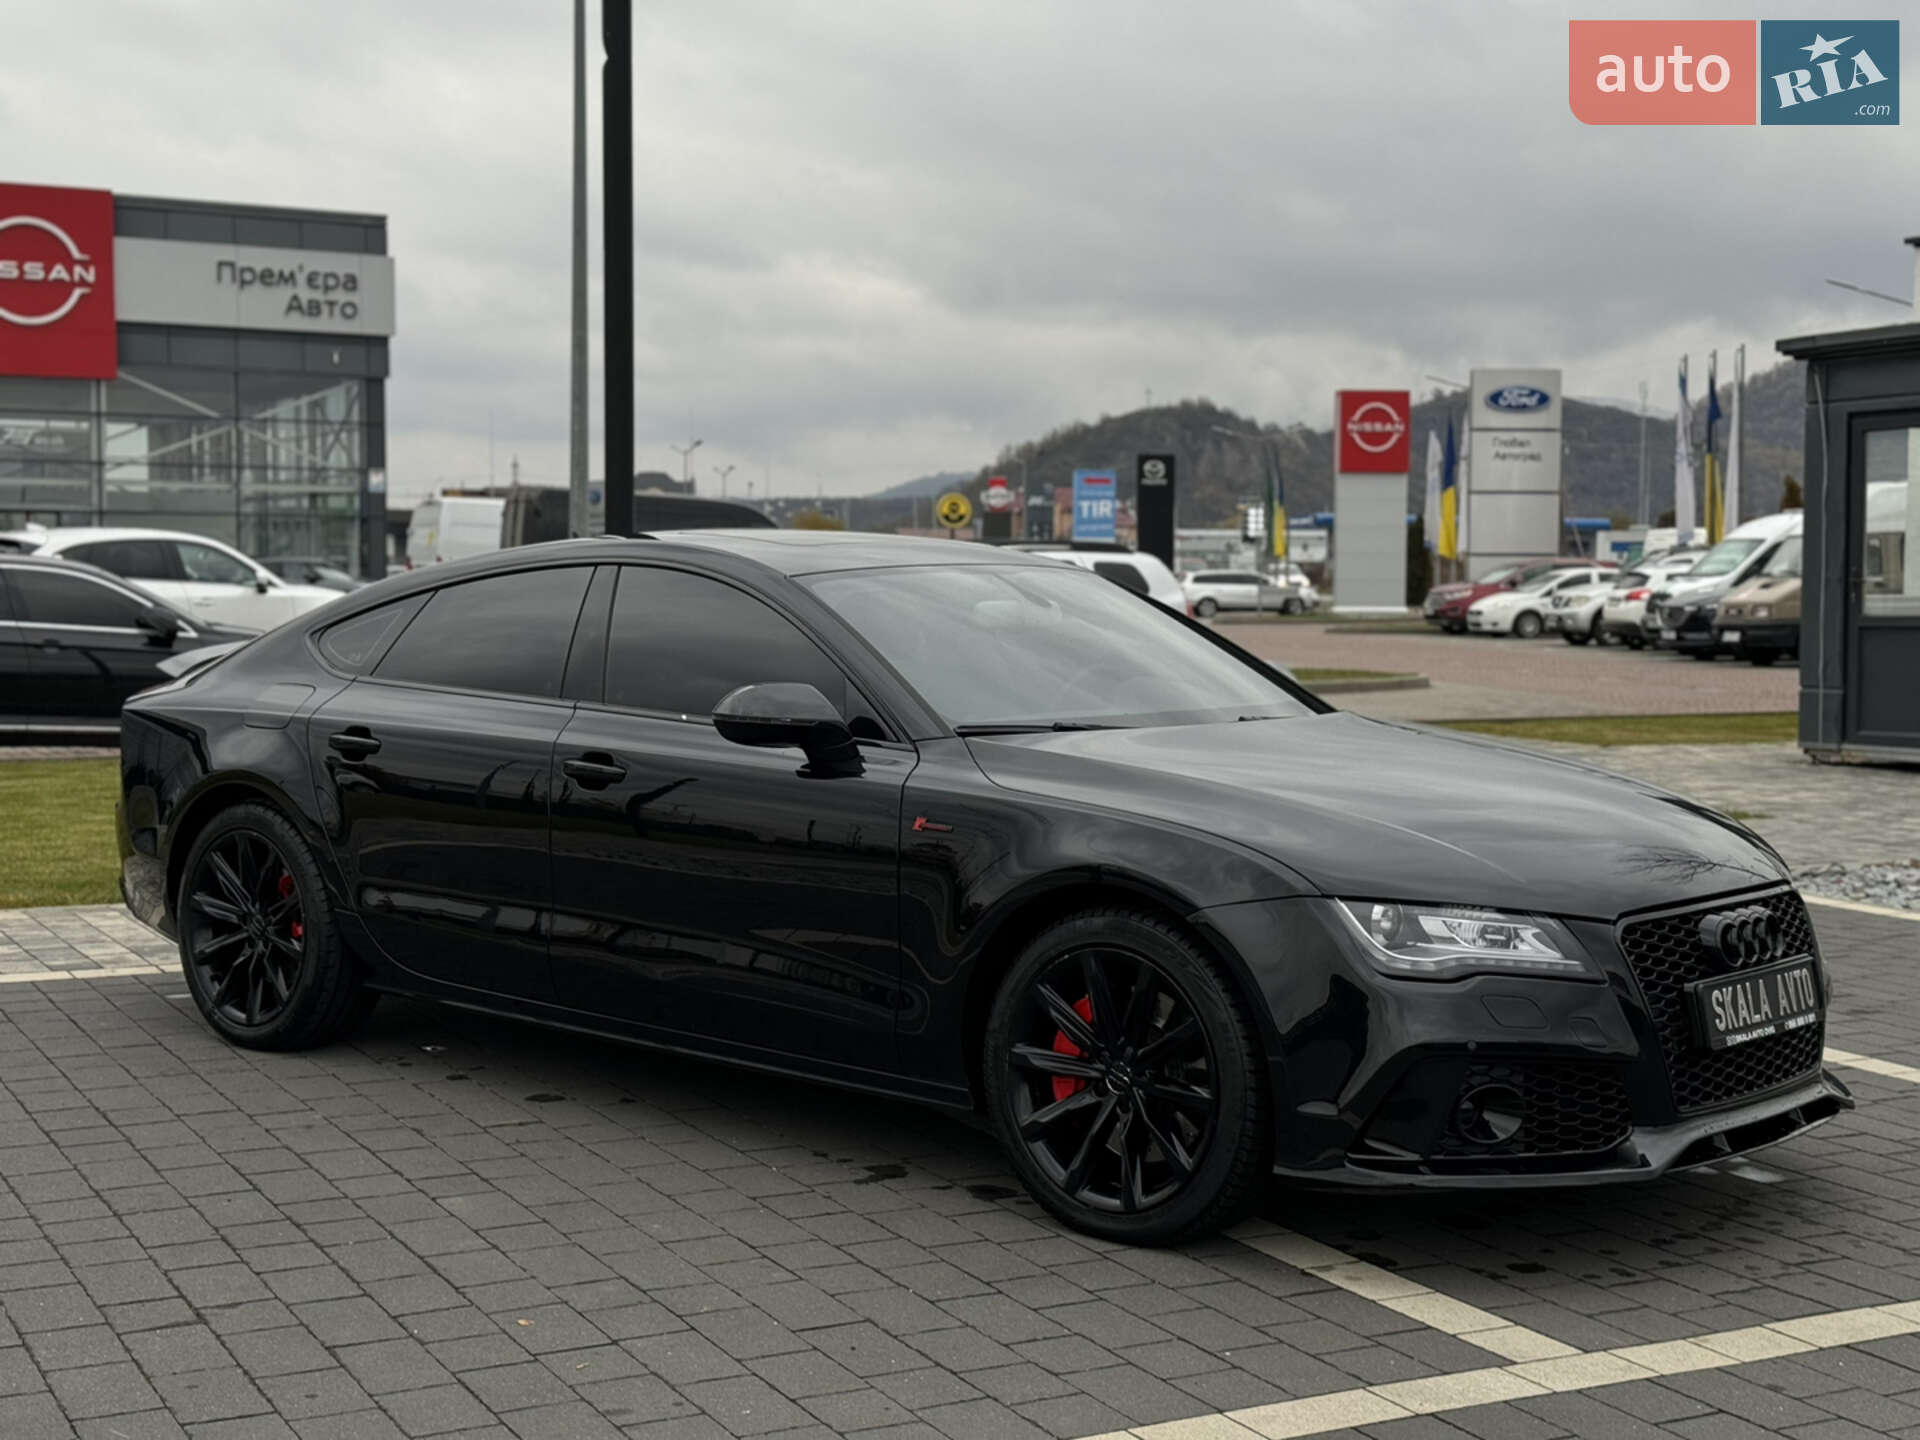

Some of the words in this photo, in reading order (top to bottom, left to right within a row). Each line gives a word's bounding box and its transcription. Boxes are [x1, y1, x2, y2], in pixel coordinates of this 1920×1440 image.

[284, 293, 359, 320] Авто
[1500, 388, 1541, 408] Ford
[1347, 422, 1405, 432] NISSAN
[1079, 499, 1113, 519] TIR
[1711, 978, 1773, 1032] SKALA
[1777, 967, 1816, 1016] AVTO
